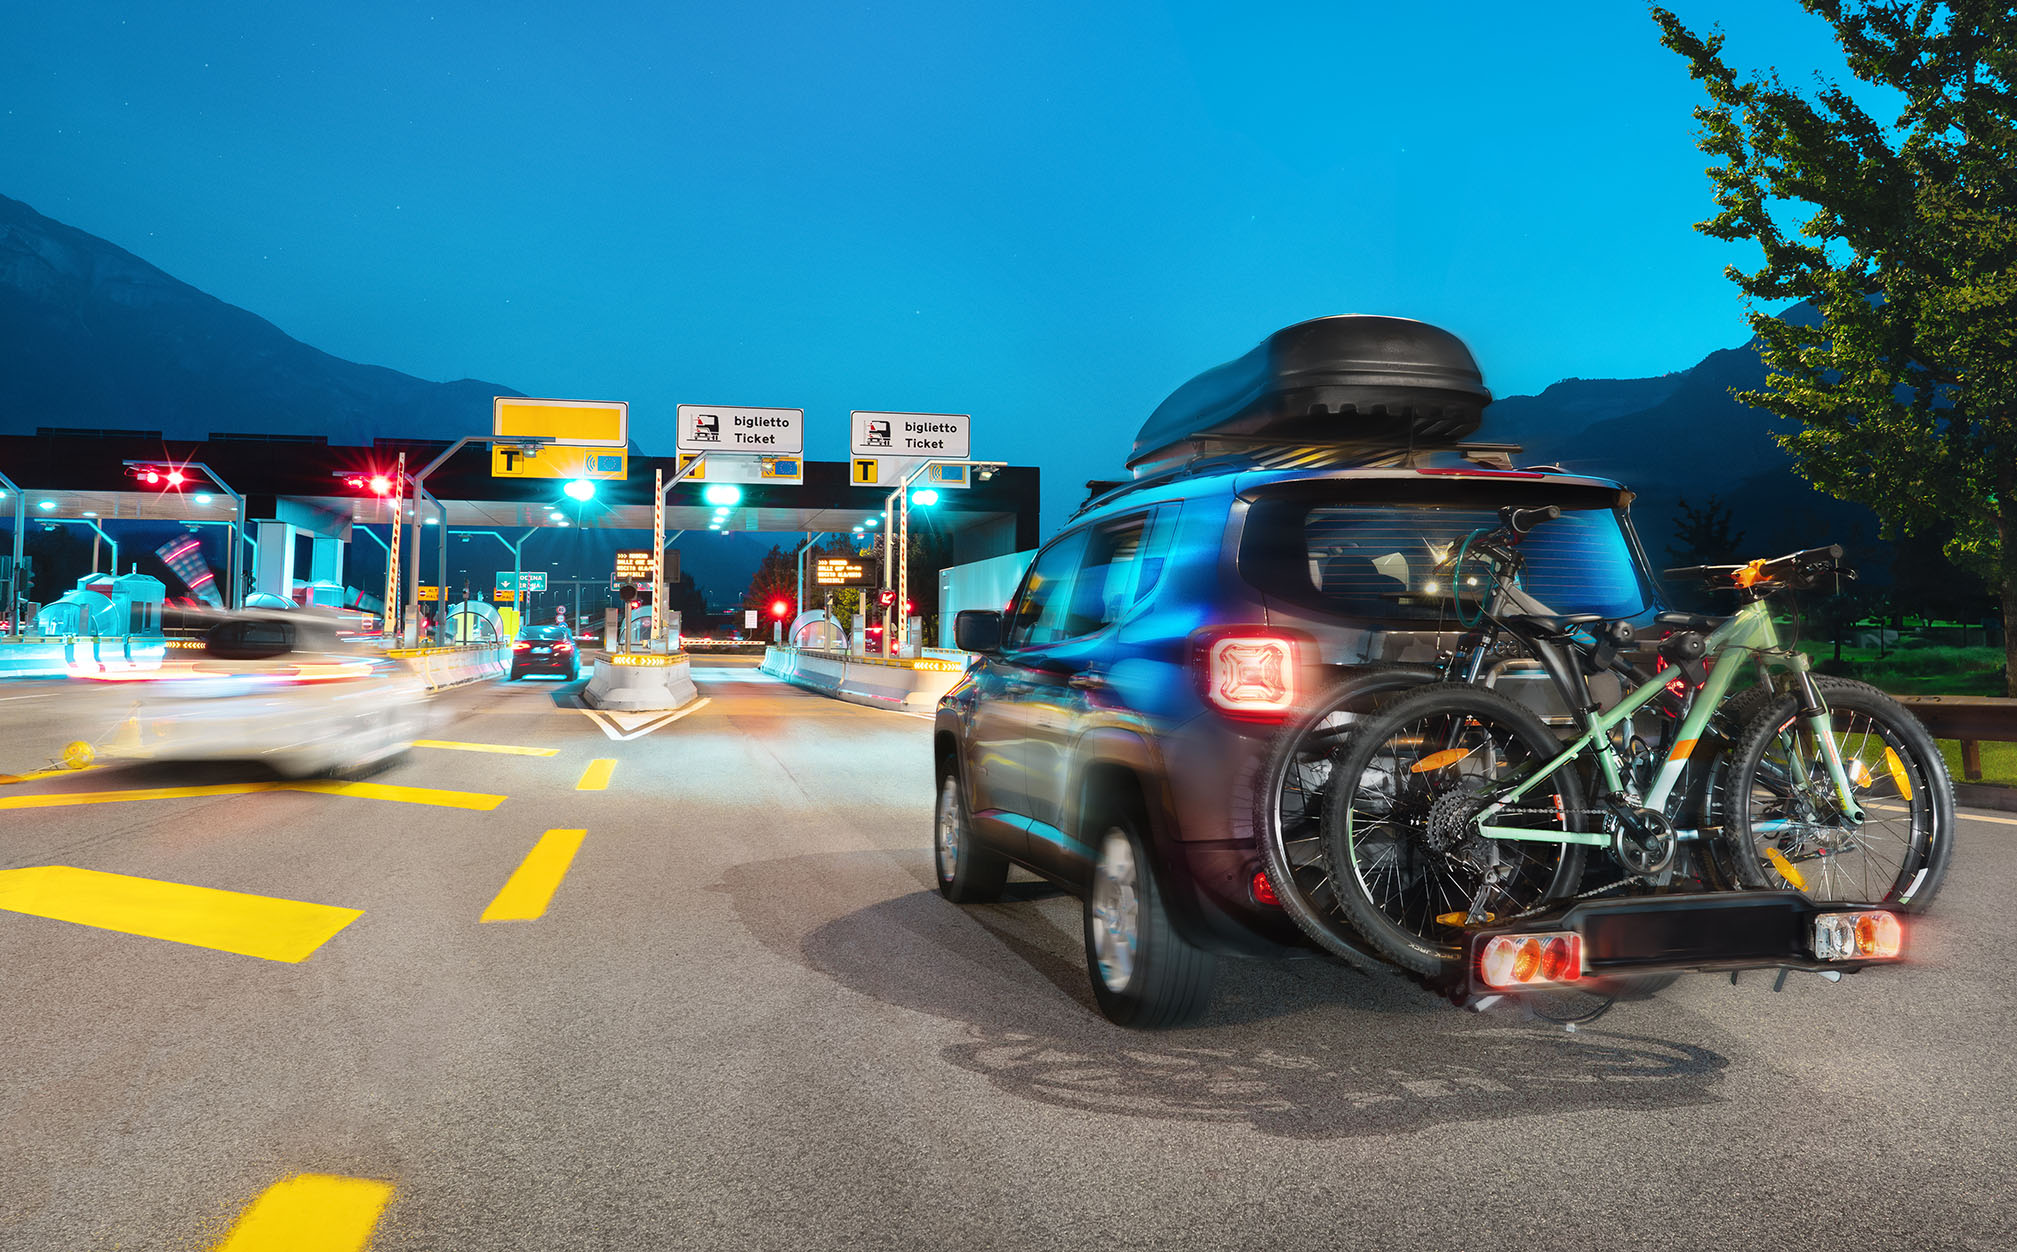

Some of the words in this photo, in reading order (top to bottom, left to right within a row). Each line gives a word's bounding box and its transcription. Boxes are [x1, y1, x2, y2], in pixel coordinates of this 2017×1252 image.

[734, 416, 790, 428] biglietto
[905, 422, 957, 433] biglietto
[734, 433, 776, 444] Ticket
[905, 438, 944, 449] Ticket
[500, 450, 519, 471] T
[857, 461, 874, 480] T
